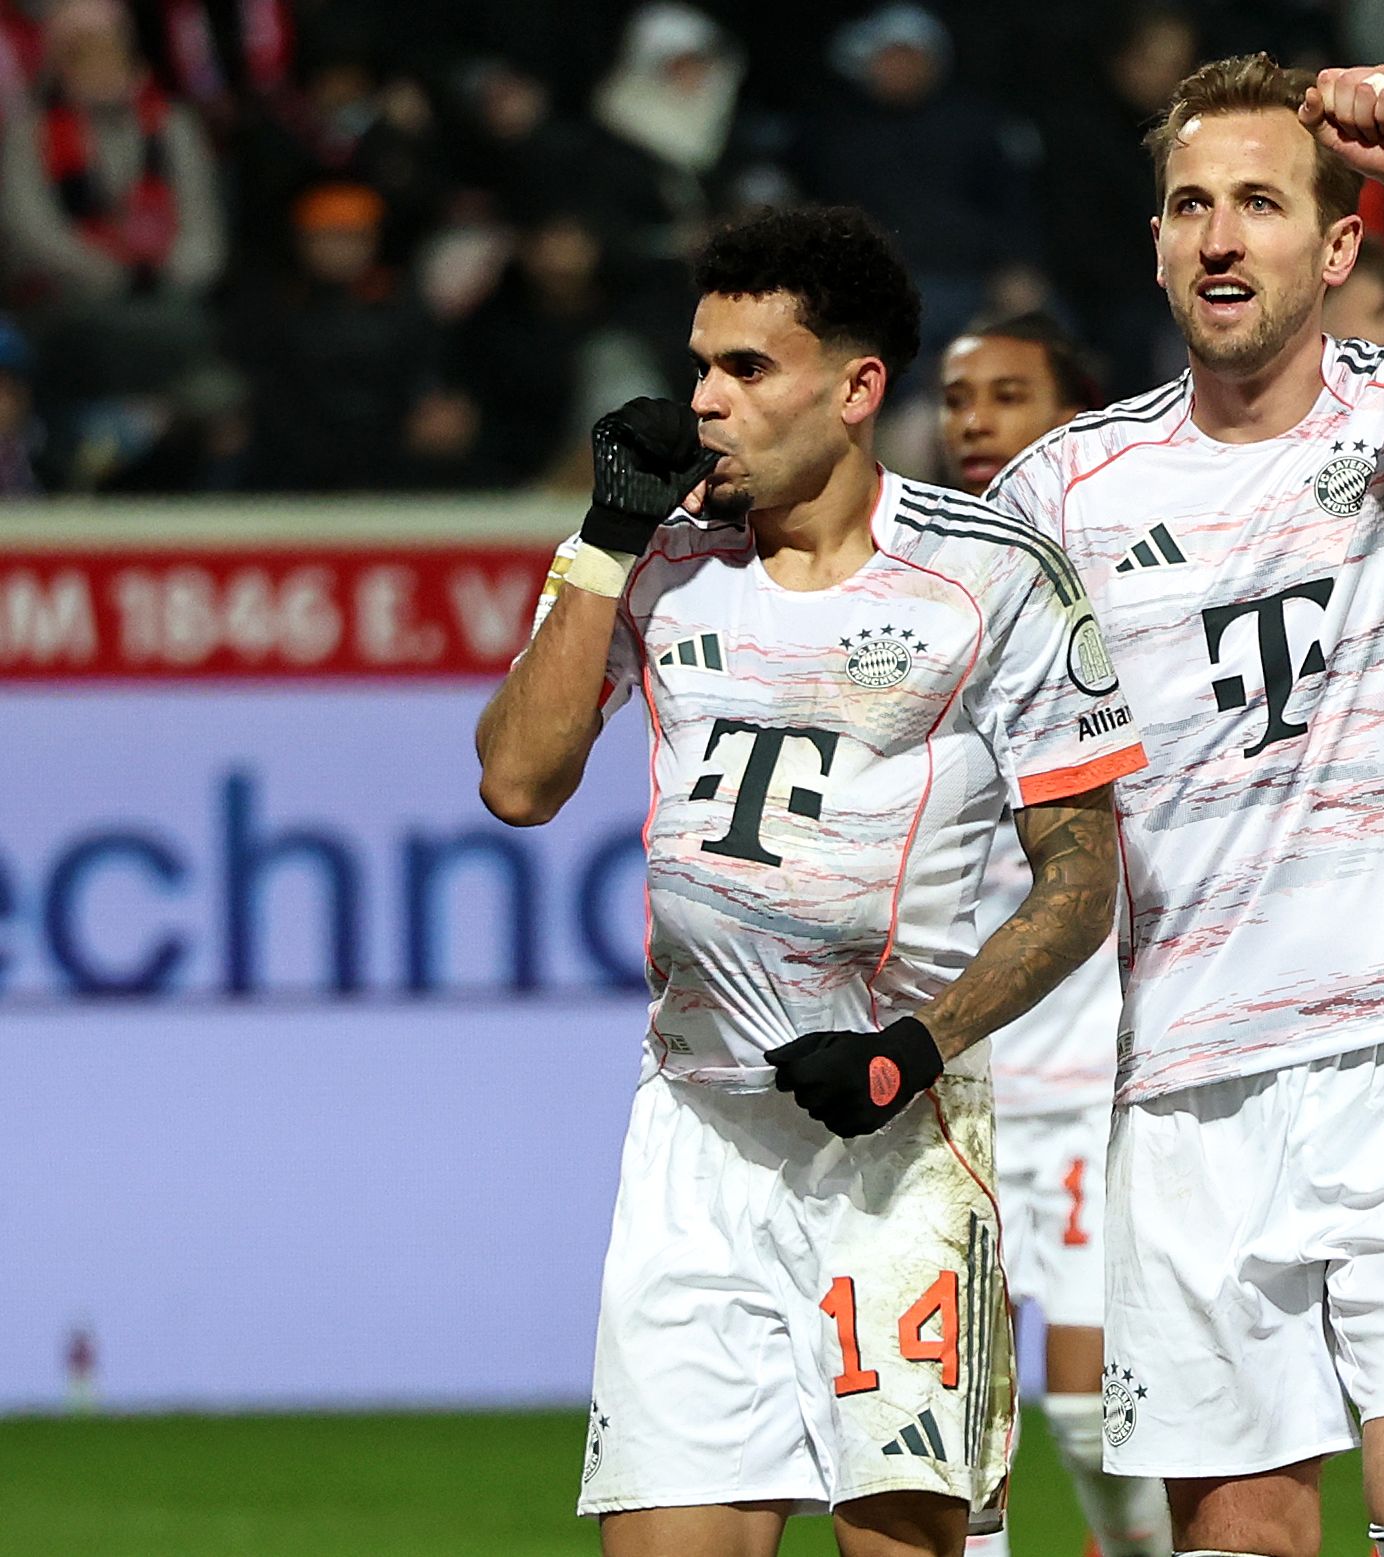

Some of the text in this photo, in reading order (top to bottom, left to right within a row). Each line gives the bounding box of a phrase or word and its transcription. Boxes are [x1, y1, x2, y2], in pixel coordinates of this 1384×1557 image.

[1328, 459, 1372, 477] BAYERN
[108, 564, 343, 666] 1846
[689, 718, 840, 868] T
[820, 1270, 960, 1398] 14
